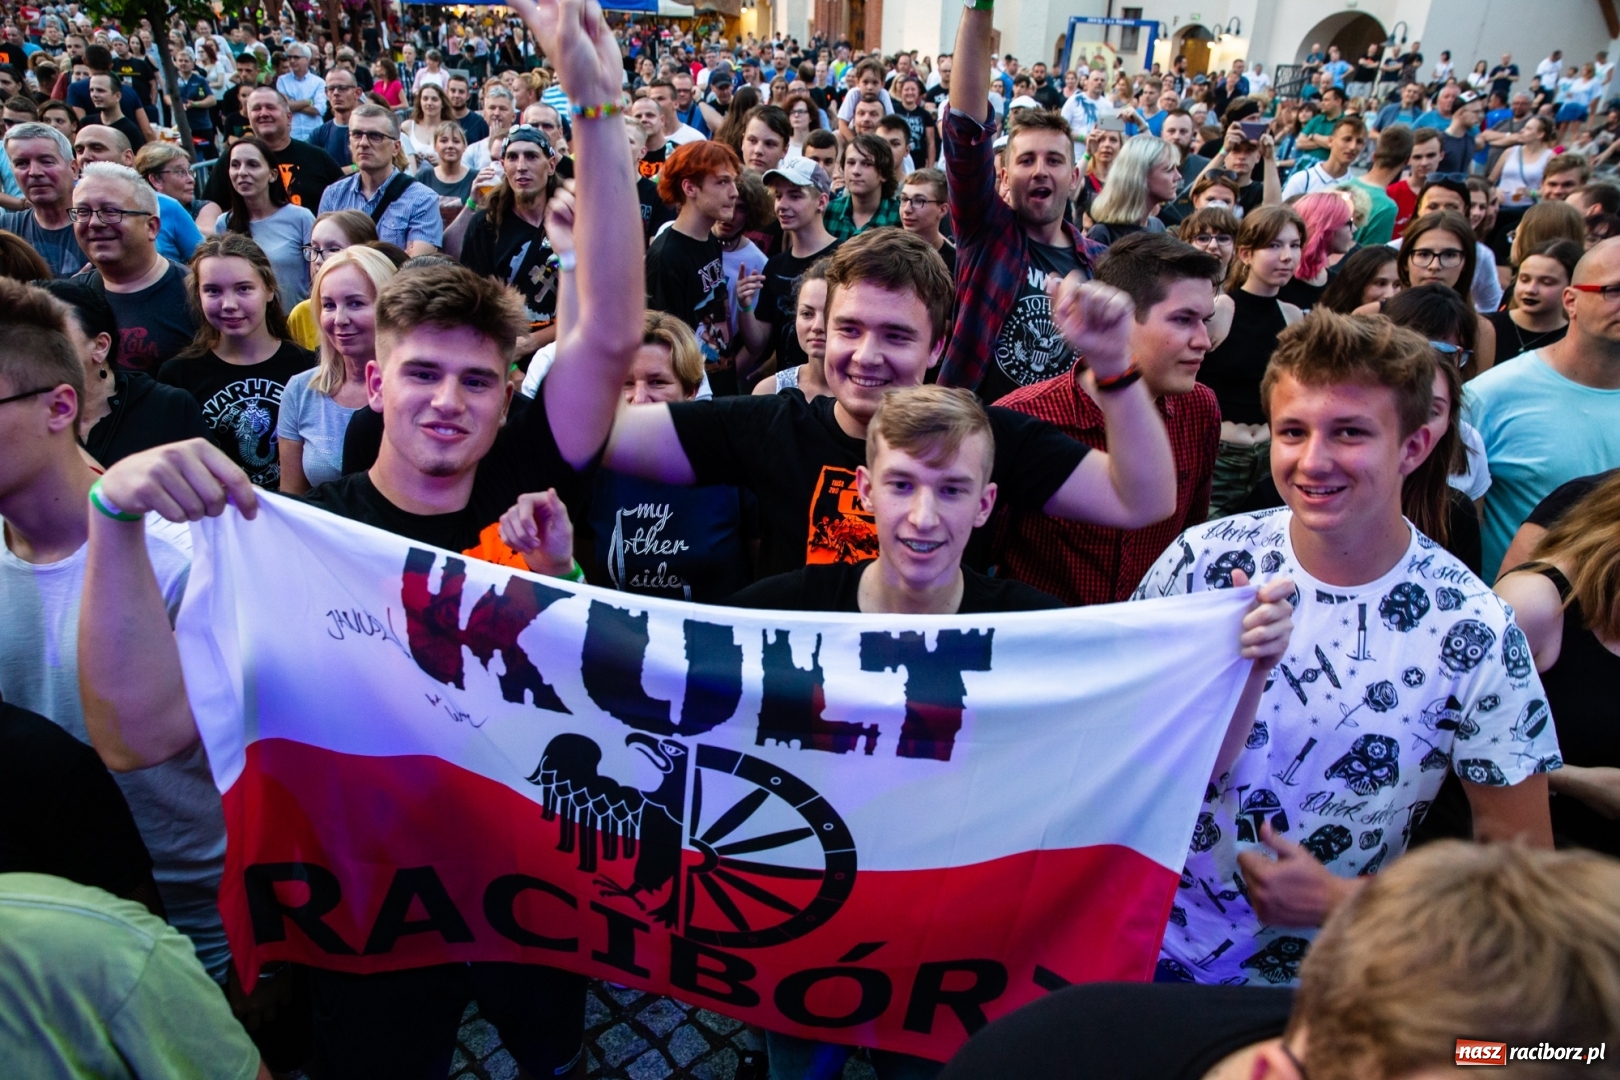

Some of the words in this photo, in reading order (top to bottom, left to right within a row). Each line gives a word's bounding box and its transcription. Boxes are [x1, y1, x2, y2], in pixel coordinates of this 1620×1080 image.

[1025, 298, 1054, 313] JOH
[623, 503, 673, 532] my
[629, 561, 682, 588] side
[401, 547, 995, 762] KULT
